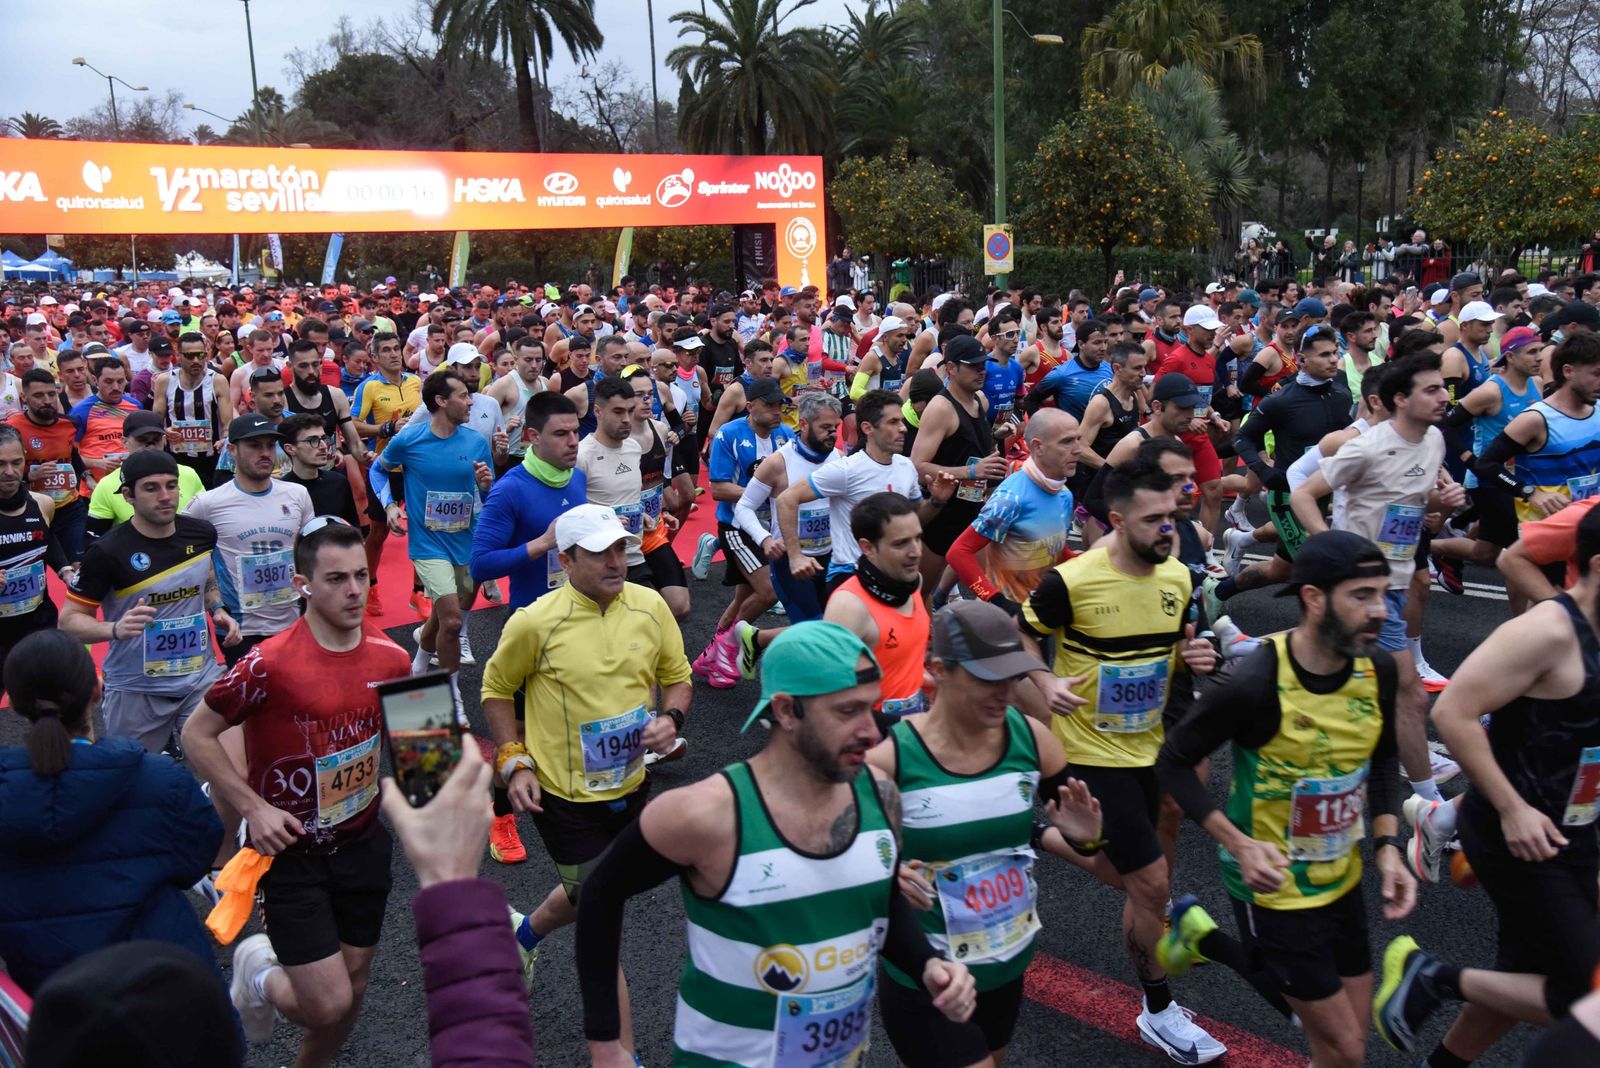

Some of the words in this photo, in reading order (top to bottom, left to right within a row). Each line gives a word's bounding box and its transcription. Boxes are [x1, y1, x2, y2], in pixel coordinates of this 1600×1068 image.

[188, 164, 320, 190] maratón
[697, 181, 750, 196] Sprinter
[226, 189, 321, 212] sevilla
[454, 177, 526, 203] HOKA
[536, 196, 587, 207] HYUNDAI
[754, 232, 764, 266] FINISH
[180, 428, 205, 439] 1012
[436, 503, 464, 515] 4061
[644, 497, 660, 514] 869
[254, 565, 287, 585] 3987
[1, 578, 35, 598] 2251
[156, 631, 197, 652] 2912
[1111, 680, 1156, 703] 3608
[597, 728, 641, 759] 1940
[271, 767, 312, 798] 30
[332, 756, 374, 791] 4733
[964, 867, 1025, 912] 4009
[802, 1010, 865, 1053] 3985
